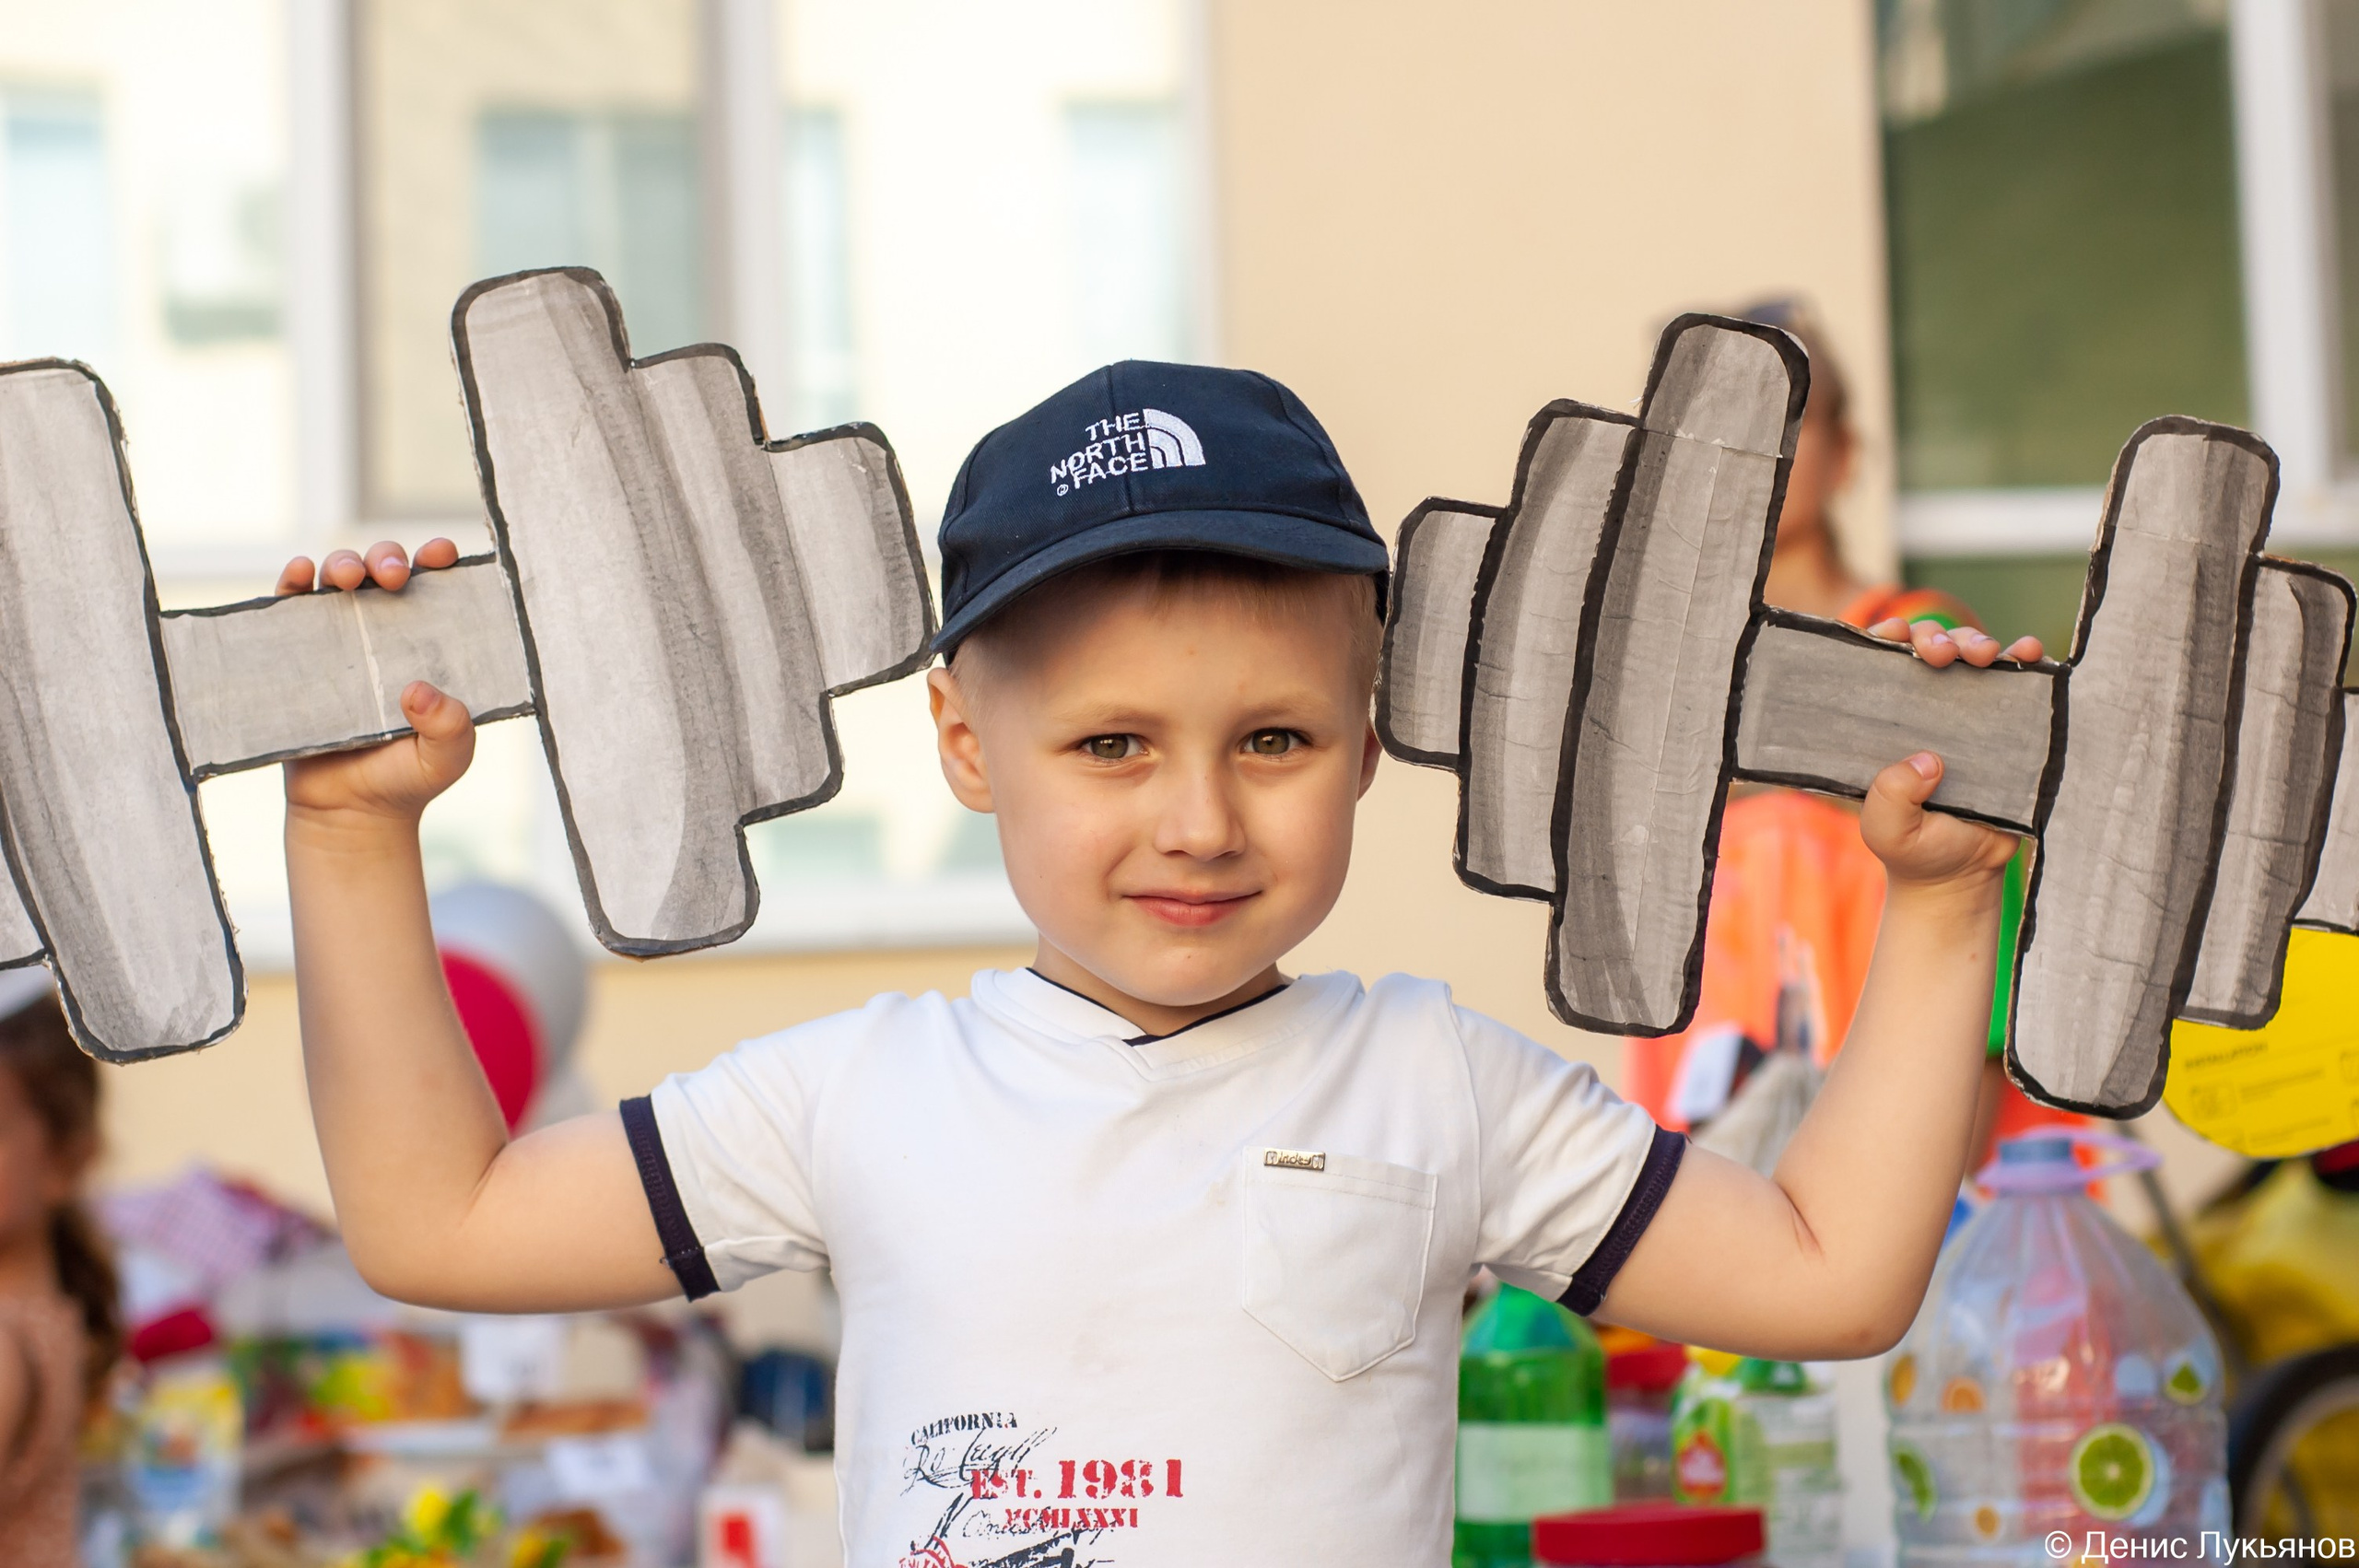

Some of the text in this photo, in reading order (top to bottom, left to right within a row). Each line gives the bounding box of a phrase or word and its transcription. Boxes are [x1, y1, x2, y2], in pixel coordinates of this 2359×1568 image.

[1086, 412, 1140, 441] THE
[1050, 431, 1145, 485] NORTH
[1074, 452, 1148, 490] FACE
[911, 1411, 1018, 1445] CALIFORNIA
[971, 1469, 1042, 1500] EST.
[1057, 1459, 1183, 1499] 1981
